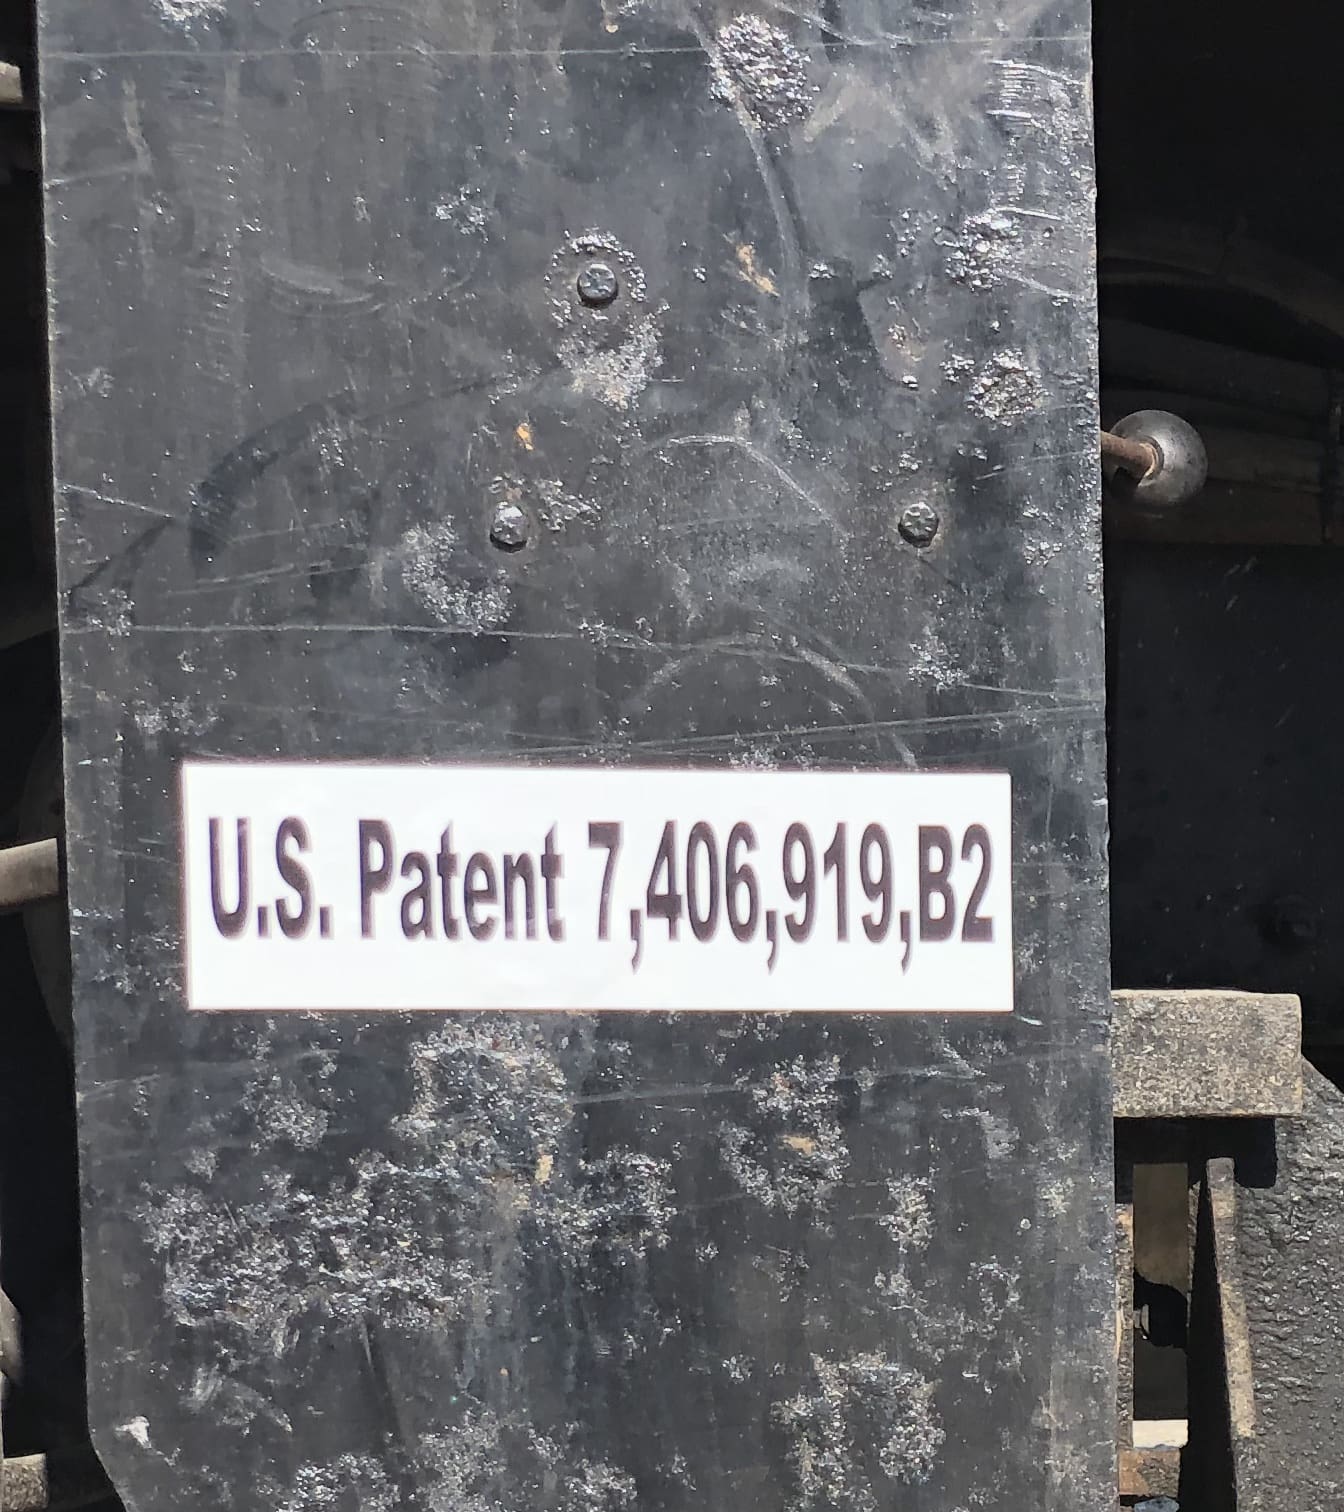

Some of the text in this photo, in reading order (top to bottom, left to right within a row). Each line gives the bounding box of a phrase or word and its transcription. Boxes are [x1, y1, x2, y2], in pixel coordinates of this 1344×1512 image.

[207, 816, 995, 975] U.S. Patent 7,406,919,B2
